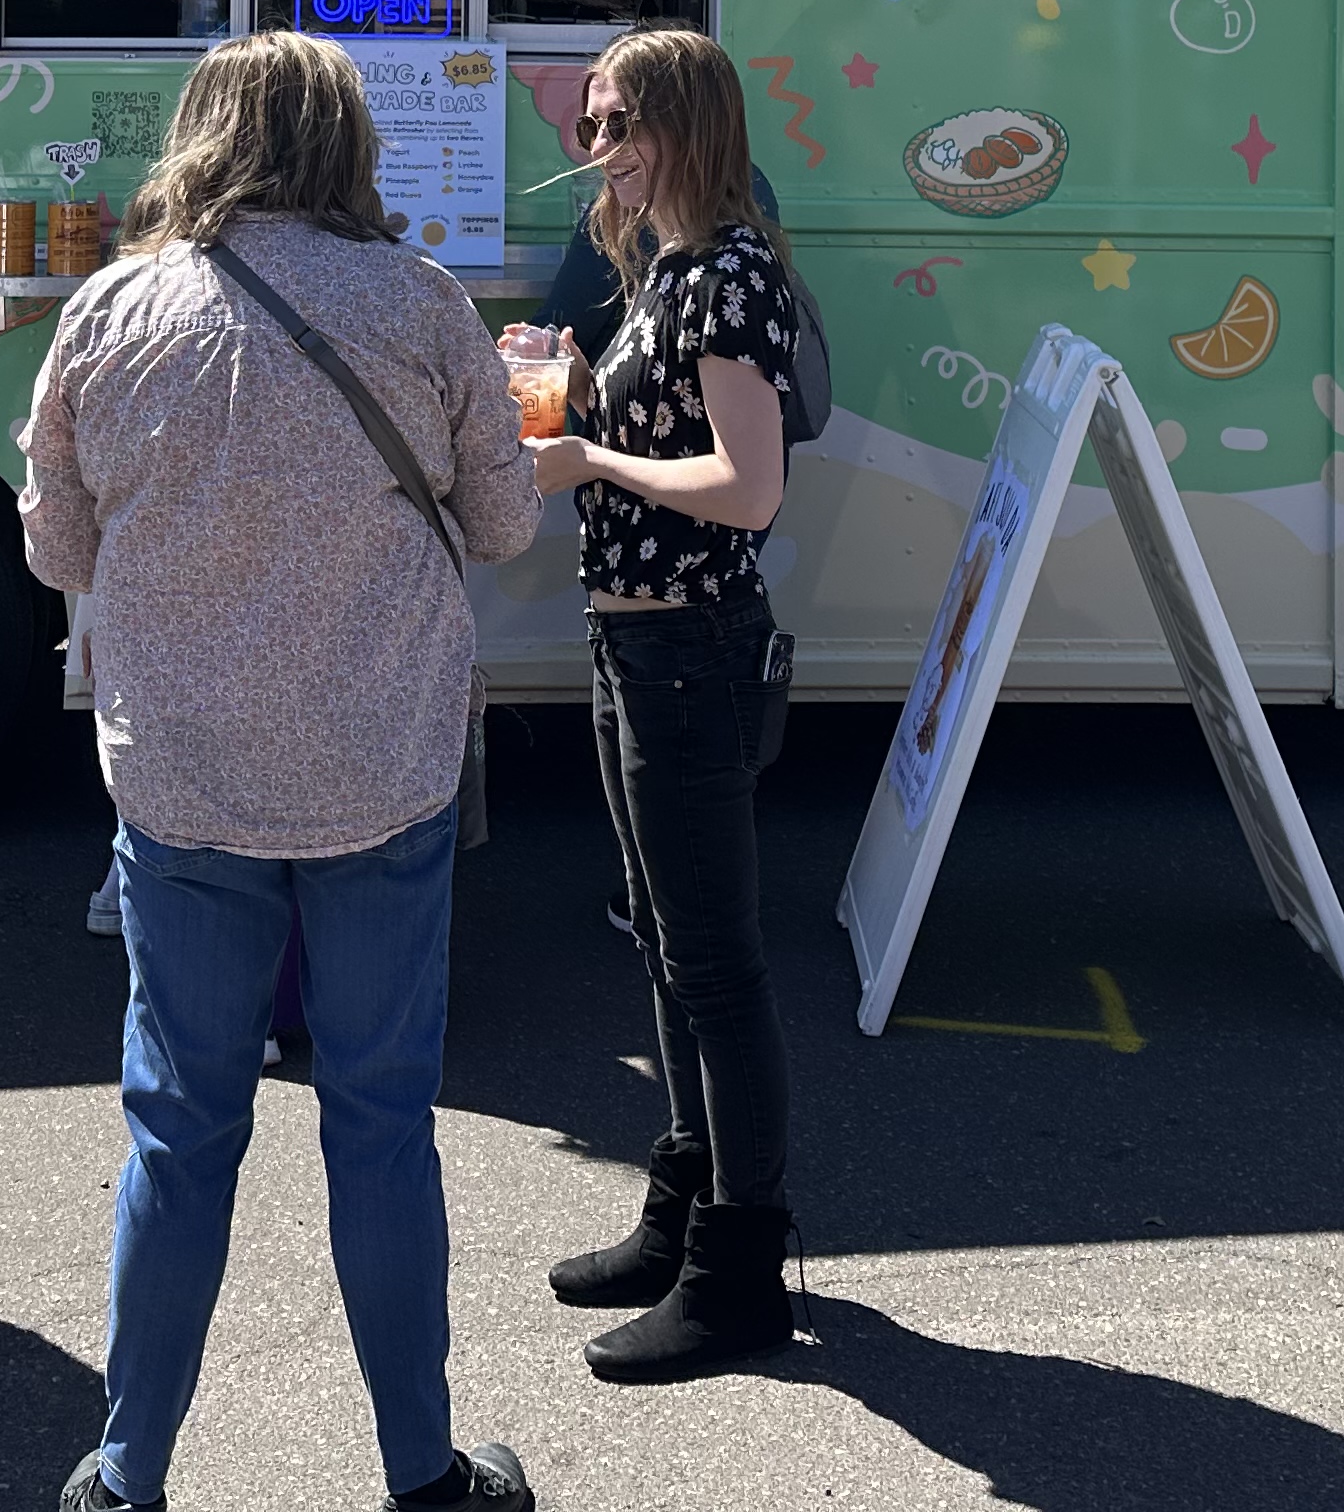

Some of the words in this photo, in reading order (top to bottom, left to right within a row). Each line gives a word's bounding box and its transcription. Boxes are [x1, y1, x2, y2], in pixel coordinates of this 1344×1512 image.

[452, 62, 488, 78] $6.85
[439, 93, 488, 114] BAR
[47, 141, 98, 163] TRASH
[403, 163, 438, 171] Raspberry
[385, 177, 419, 185] Pineapple
[457, 186, 483, 194] Orange
[461, 216, 499, 224] TOPPINGS
